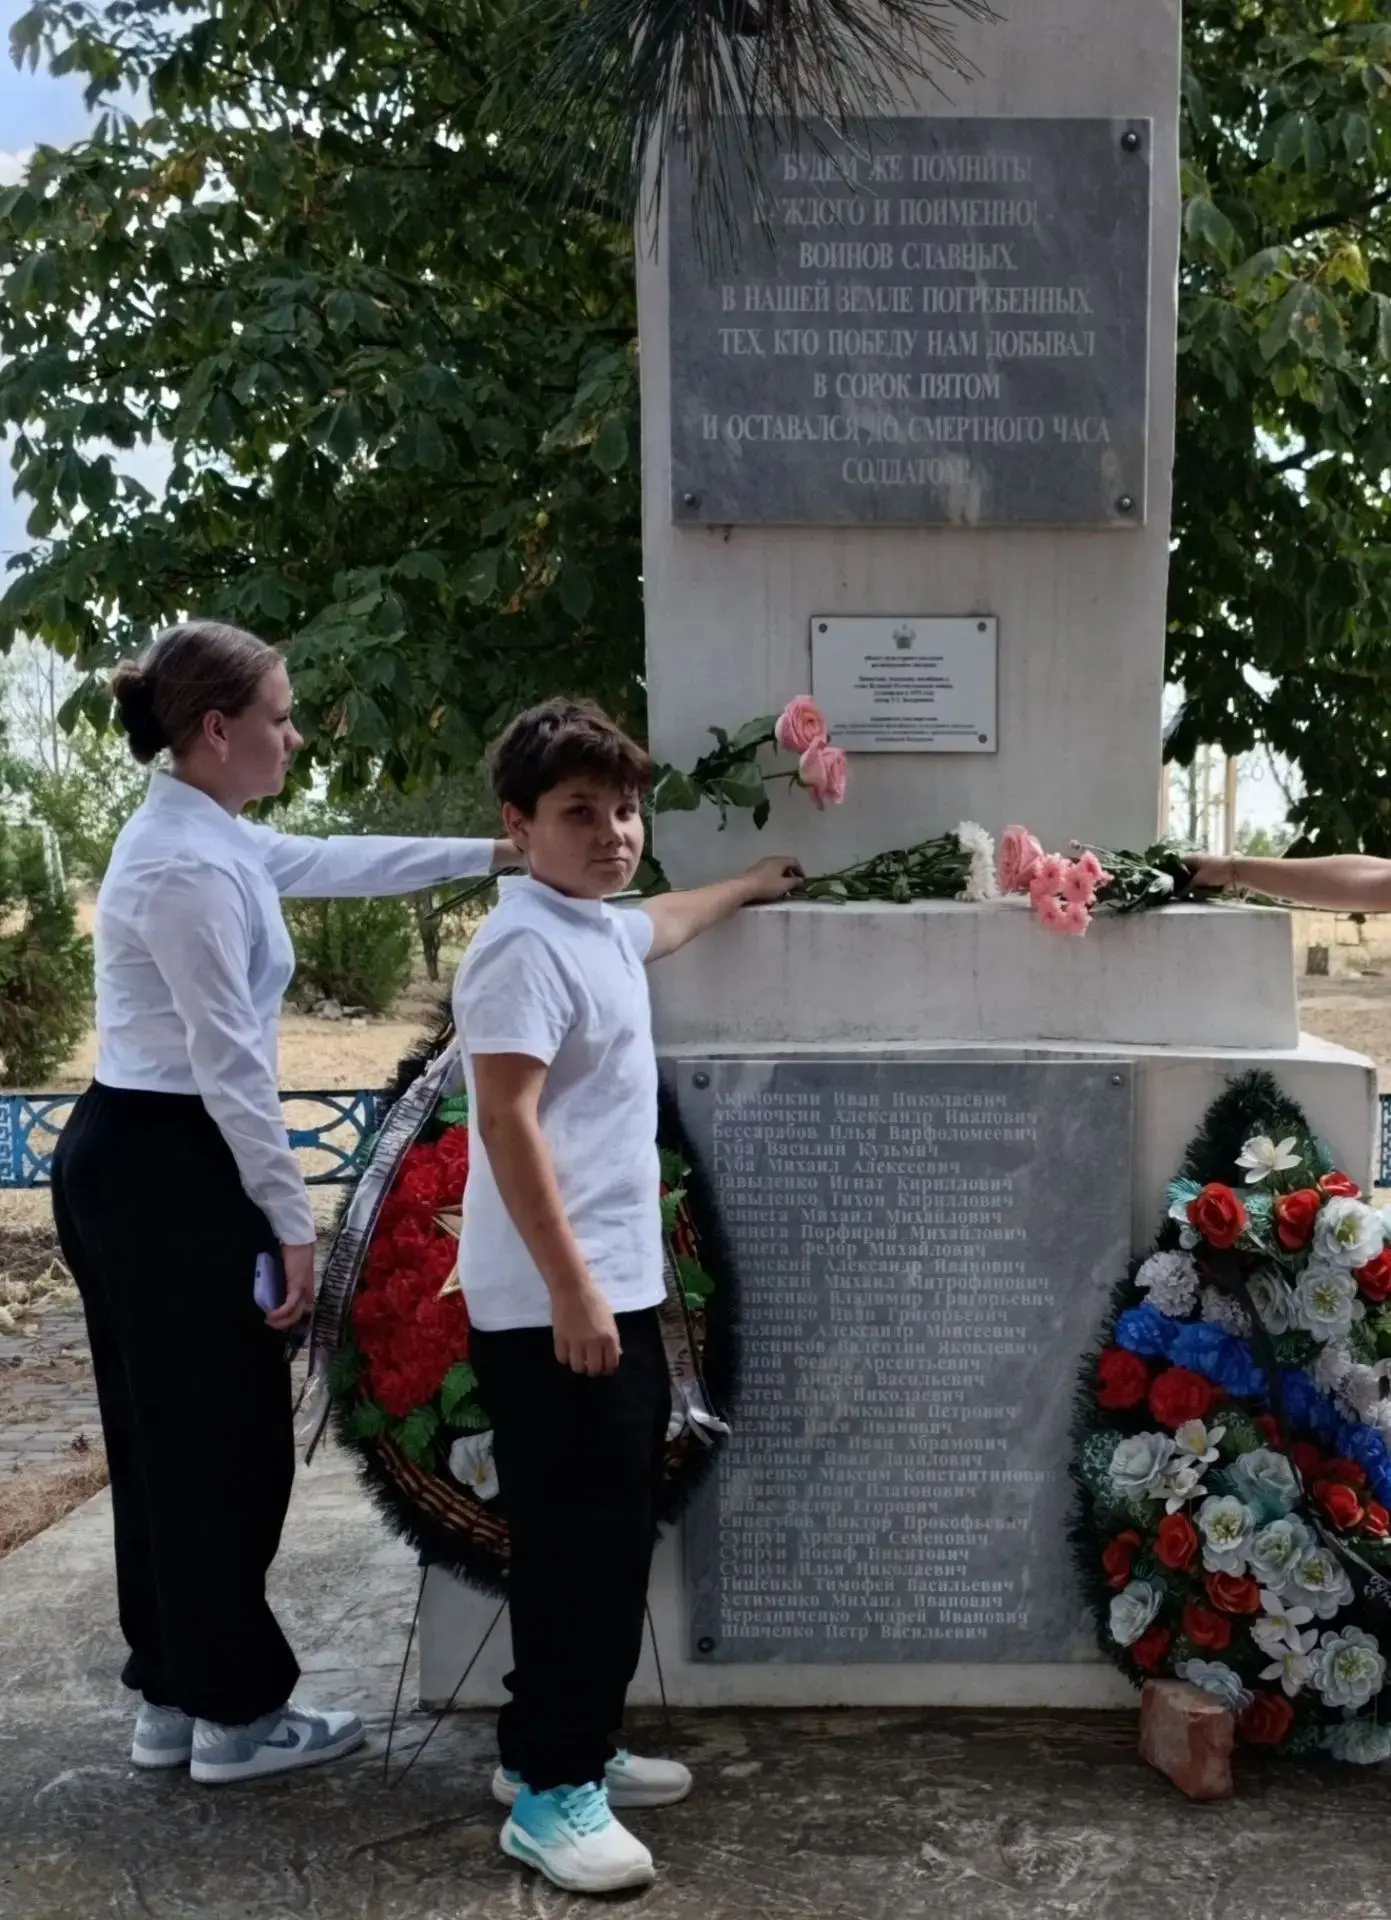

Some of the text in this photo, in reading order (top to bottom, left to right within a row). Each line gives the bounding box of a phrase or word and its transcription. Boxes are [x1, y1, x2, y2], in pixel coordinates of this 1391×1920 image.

[869, 155, 903, 182] ЖЕ
[873, 200, 891, 226] И
[800, 242, 893, 269] ВОИНОВ
[722, 286, 735, 312] В
[745, 281, 829, 312] НАШЕЙ
[836, 286, 912, 312] ЗЕМЛЕ
[773, 330, 818, 357] КТО
[829, 330, 918, 359] ПОБЕДУ
[927, 330, 977, 357] НАМ
[986, 330, 1096, 359] ДОБЫВАЛ
[813, 373, 1000, 398] В СОРОК ПЯТОМ
[702, 417, 1110, 443] И ОСТАВАЛСЯ ДО СМЕРТНОГО ЧАСА
[833, 1091, 879, 1107] Иван
[893, 1091, 1006, 1107] Николаевич
[833, 1109, 933, 1127] Александр
[945, 1109, 1037, 1124] Иванович
[712, 1125, 1037, 1143] Бессарабов Илья Варфоломеевич
[712, 1141, 938, 1159] Губа Василий Кузьмич
[712, 1159, 960, 1176] Губа Михаил Алексеевич
[830, 1175, 884, 1191] Игнат
[897, 1175, 1013, 1194] Кириллович
[830, 1192, 885, 1207] Тихон
[897, 1192, 1014, 1210] Кириллович
[801, 1210, 873, 1223] Михаил
[886, 1210, 1002, 1223] Михайлович
[801, 1226, 897, 1242] Порфирий
[909, 1226, 1027, 1239] Михайлович
[801, 1243, 857, 1259] Федор
[869, 1243, 985, 1256] Михайлович
[824, 1259, 922, 1275] Александр
[934, 1259, 1025, 1272] Иванович
[824, 1276, 895, 1289] Михаил
[830, 1292, 922, 1308] Владимир
[934, 1292, 1055, 1308] Григорьевич
[830, 1309, 875, 1321] Иван
[888, 1309, 1008, 1325] Григорьевич
[817, 1326, 914, 1340] Александр
[926, 1326, 1026, 1337] Моисеевич
[838, 1341, 925, 1354] Валентин
[938, 1341, 1038, 1354] Яковлевич
[877, 1374, 985, 1386] Васильевич
[795, 1389, 841, 1401] Илья
[853, 1389, 964, 1401] Николаевич
[804, 1421, 850, 1433] Илья
[862, 1421, 952, 1433] Иванович
[849, 1437, 894, 1450] Иван
[824, 1452, 869, 1466] Иван
[820, 1468, 889, 1481] Максим
[827, 1515, 891, 1532] Виктор
[799, 1562, 844, 1576] Илья
[857, 1562, 966, 1576] Николаевич
[815, 1578, 895, 1594] Тимофей
[907, 1578, 1013, 1591] Васильевич
[914, 1594, 1002, 1607] Иванович
[939, 1609, 1028, 1622] Иванович
[826, 1625, 868, 1641] Петр
[881, 1625, 988, 1638] Васильевич
